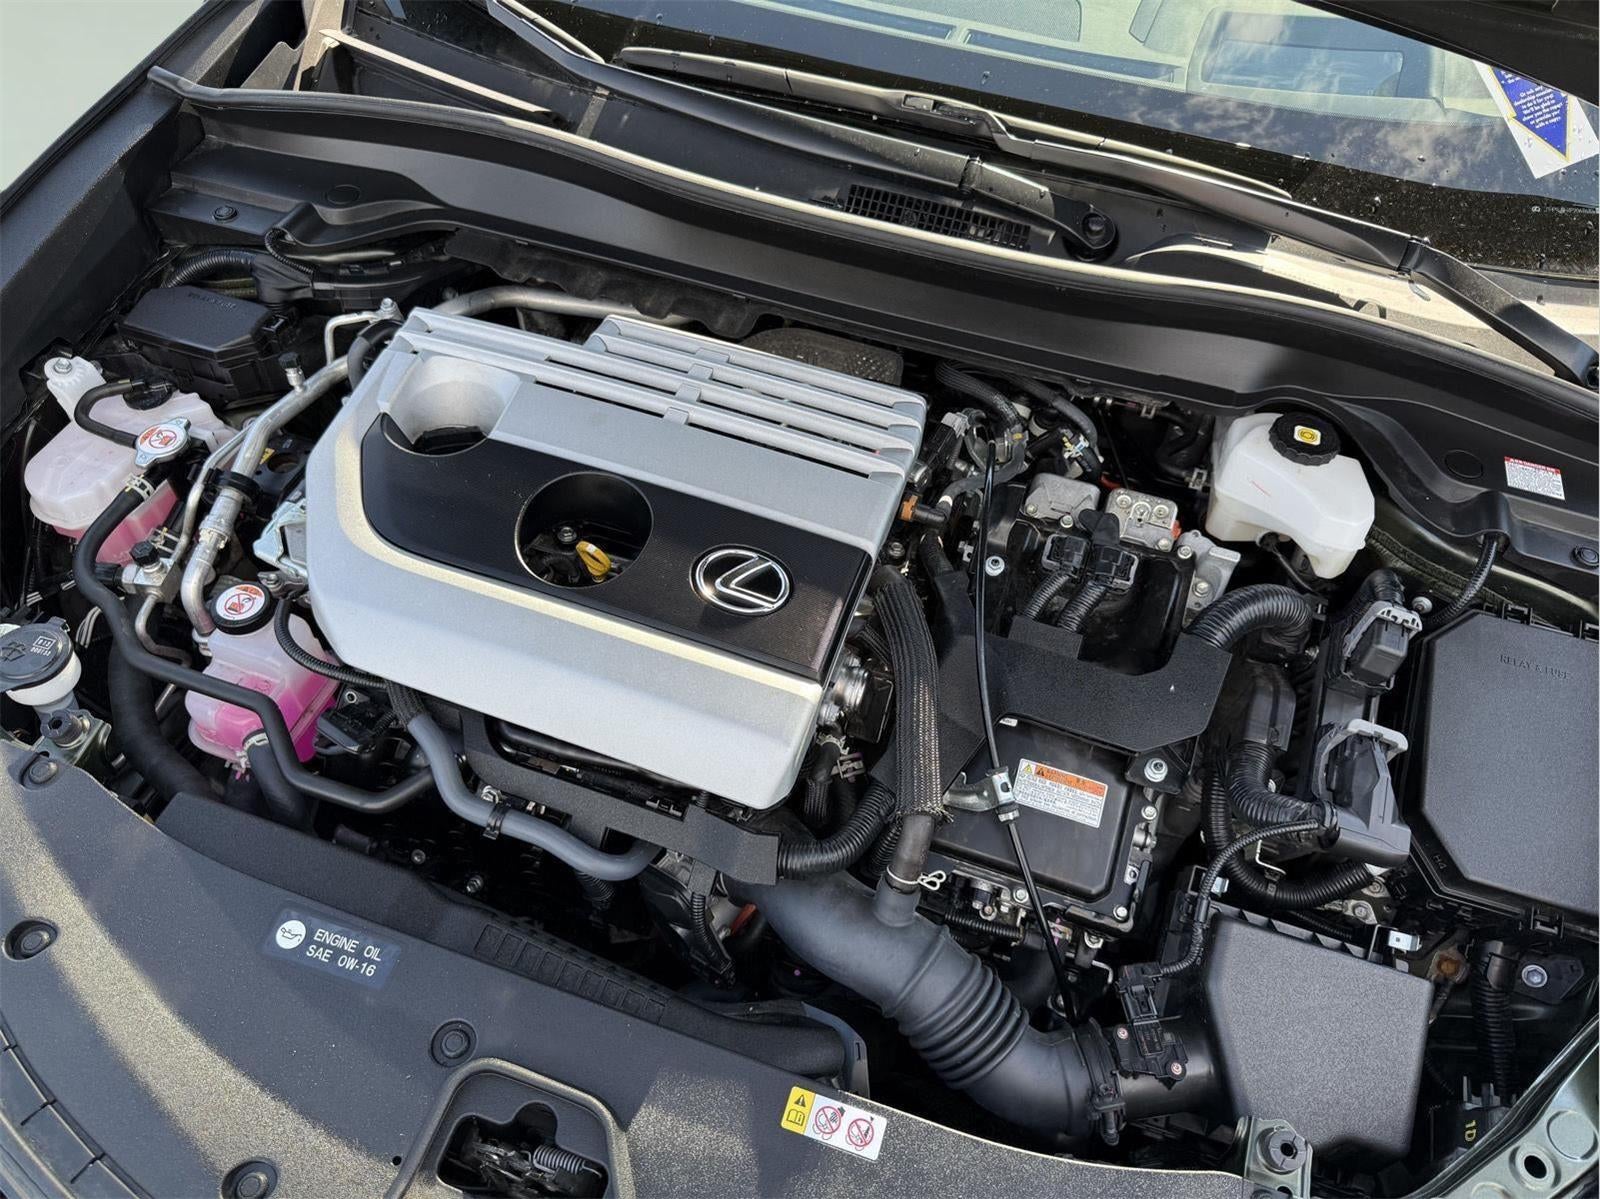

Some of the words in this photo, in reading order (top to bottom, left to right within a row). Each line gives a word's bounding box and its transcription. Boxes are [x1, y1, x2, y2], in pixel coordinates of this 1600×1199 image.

[1500, 654, 1530, 669] RELAY
[1545, 665, 1568, 679] FUSE
[314, 928, 360, 953] ENGINE
[364, 945, 382, 962] OIL
[306, 944, 334, 962] SAE
[338, 955, 376, 977] 0W-16
[1465, 1120, 1476, 1142] 1D
